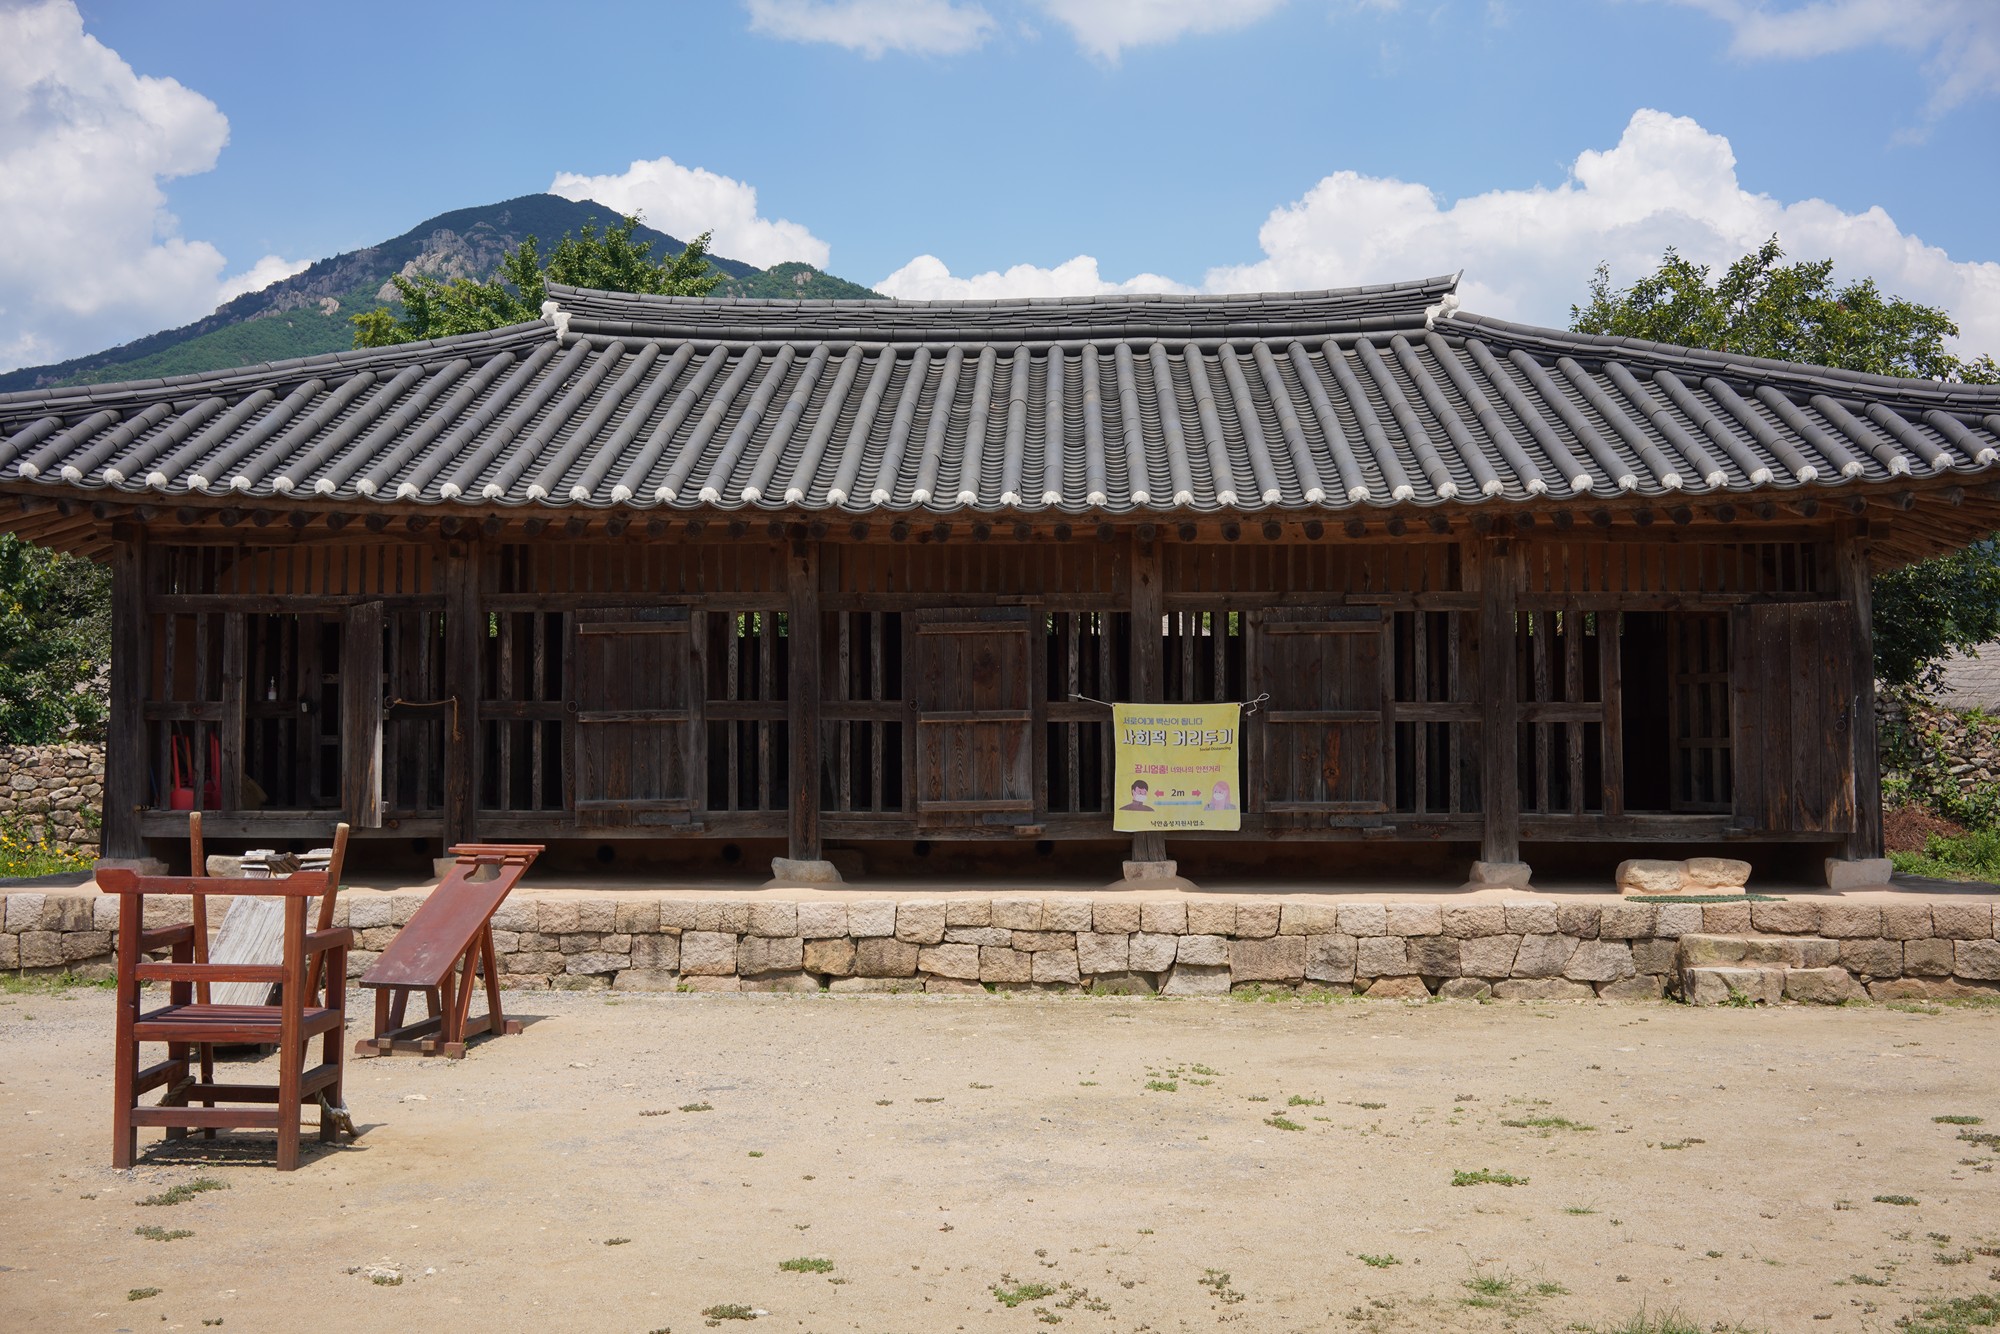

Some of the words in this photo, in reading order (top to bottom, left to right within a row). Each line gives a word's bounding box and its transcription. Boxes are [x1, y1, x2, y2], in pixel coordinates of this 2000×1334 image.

[1123, 717, 1154, 726] 서로에게
[1156, 717, 1179, 726] 백신이
[1181, 717, 1203, 726] 됩니다
[1122, 728, 1167, 747] 사회적
[1172, 728, 1234, 747] 거리두기
[1195, 765, 1221, 774] 안전거리
[1171, 788, 1185, 797] 2m
